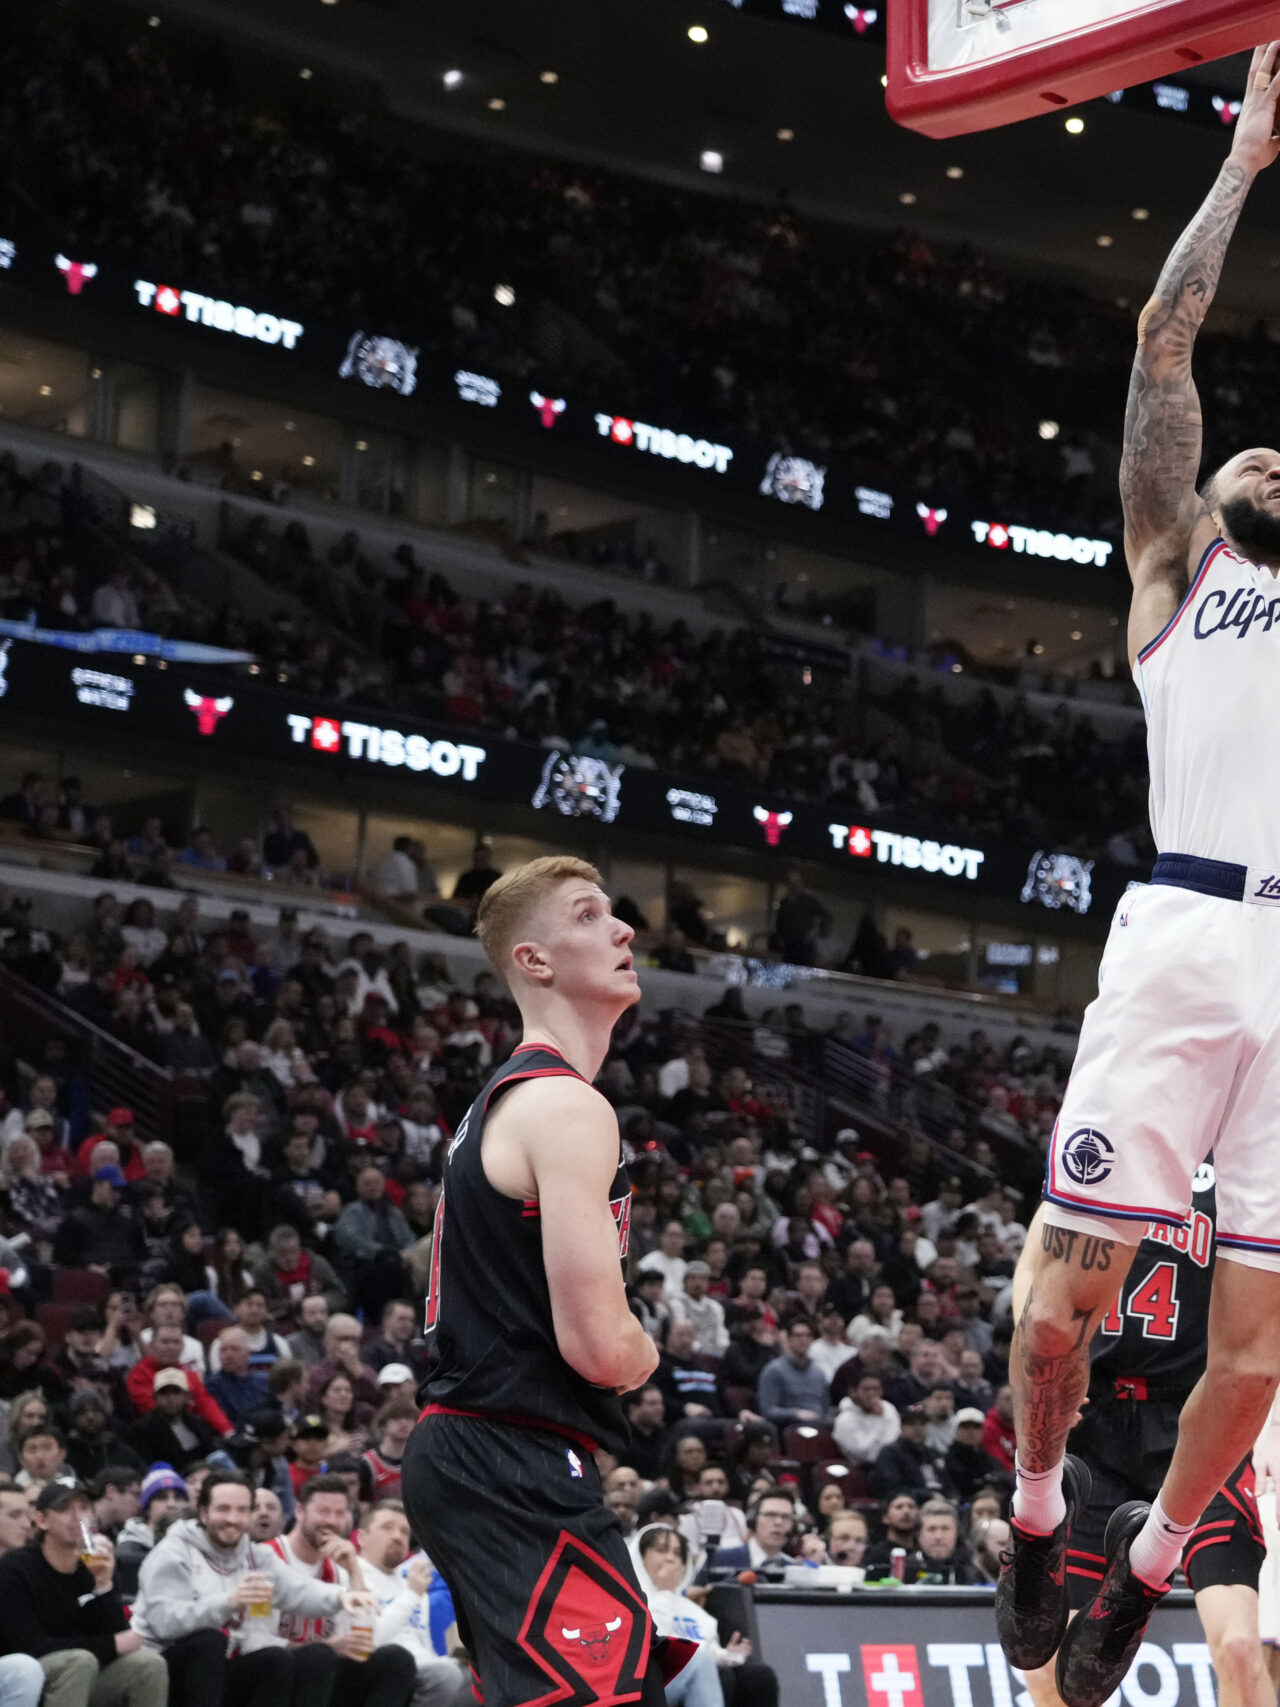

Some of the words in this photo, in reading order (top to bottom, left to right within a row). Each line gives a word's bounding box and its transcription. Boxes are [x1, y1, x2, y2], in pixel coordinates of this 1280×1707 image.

[180, 291, 303, 349] TISSOT
[632, 421, 733, 474] TISSOT
[1009, 526, 1113, 567] TISSOT
[342, 721, 486, 781] TISSOT
[871, 829, 985, 880] TISSOT
[1041, 1222, 1078, 1264] UST
[1081, 1236, 1115, 1271] US
